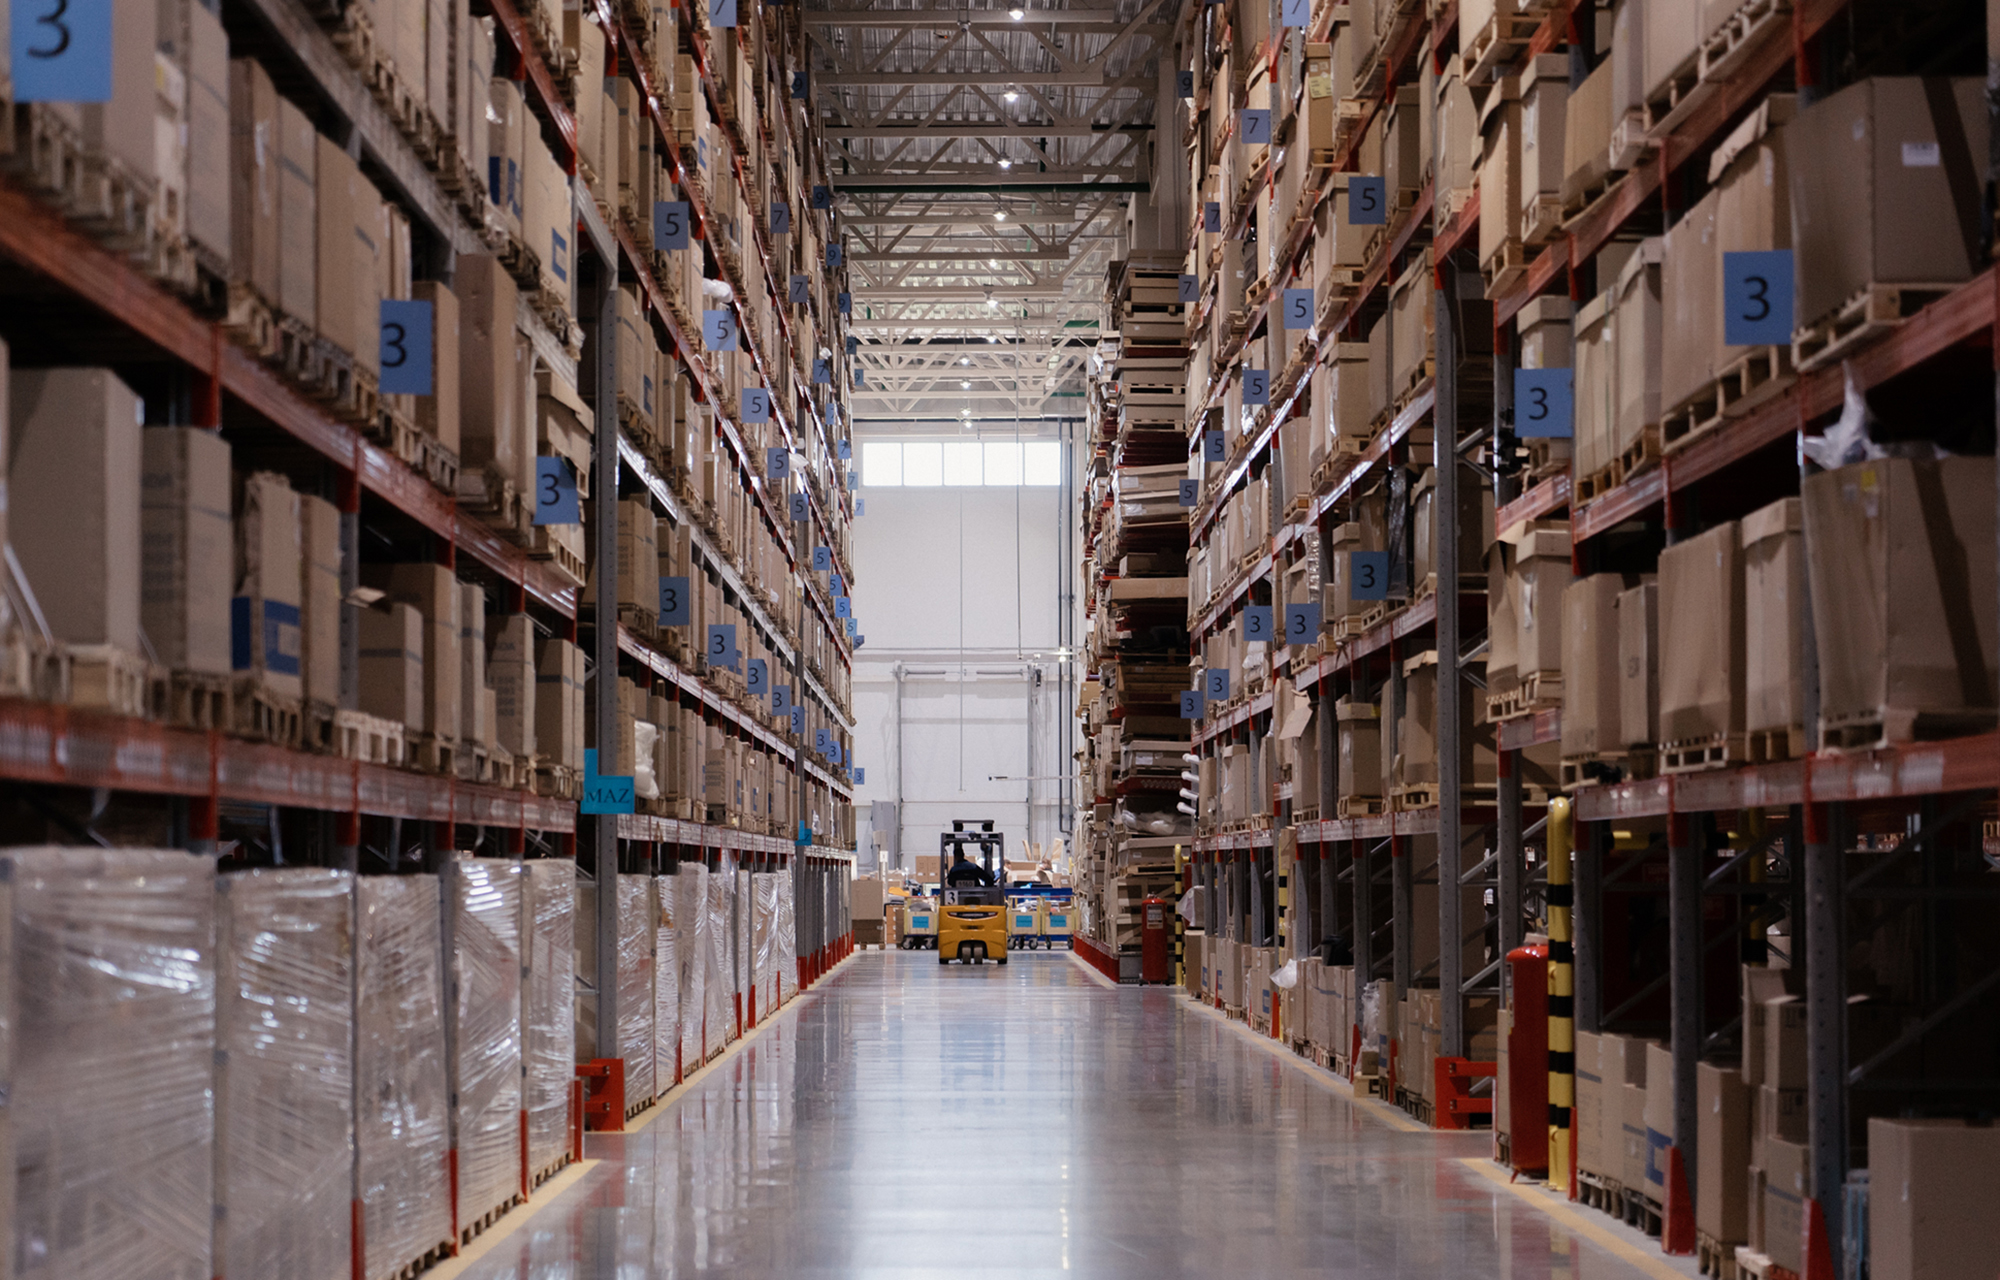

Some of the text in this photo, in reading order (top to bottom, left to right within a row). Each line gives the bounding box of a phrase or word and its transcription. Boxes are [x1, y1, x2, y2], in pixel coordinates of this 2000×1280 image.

[26, 0, 71, 60] 3
[1182, 76, 1192, 91] 9
[1247, 116, 1260, 134] 7
[814, 191, 825, 204] 9
[1361, 187, 1377, 212] 5
[773, 209, 784, 225] 7
[1210, 208, 1220, 224] 7
[664, 212, 680, 237] 5
[828, 249, 837, 261] 9
[794, 281, 804, 296] 7
[1183, 280, 1193, 295] 7
[1742, 275, 1771, 322] 3
[1294, 297, 1307, 319] 5
[716, 319, 729, 340] 5
[380, 321, 408, 368] 3
[818, 364, 827, 377] 7
[1252, 377, 1263, 396] 5
[751, 395, 763, 414] 5
[1528, 386, 1549, 421] 3
[1214, 437, 1224, 454] 5
[774, 454, 785, 470] 5
[848, 475, 856, 486] 7
[540, 472, 561, 507] 3
[1184, 484, 1194, 500] 5
[795, 499, 804, 514] 5
[855, 502, 862, 512] 7
[816, 551, 825, 565] 5
[1360, 563, 1376, 589] 3
[829, 579, 837, 591] 5
[662, 588, 678, 613] 3
[839, 601, 846, 613] 5
[847, 621, 854, 633] 5
[1250, 615, 1261, 633] 3
[1294, 614, 1307, 635] 3
[713, 633, 726, 655] 3
[748, 667, 760, 685] 3
[1213, 676, 1224, 693] 3
[772, 691, 783, 708] 3
[1185, 697, 1195, 713] 3
[791, 711, 799, 727] 3
[817, 733, 825, 747] 3
[829, 745, 837, 758] 3
[856, 771, 863, 782] 3
[585, 787, 630, 804] MAZ
[947, 891, 956, 905] 3
